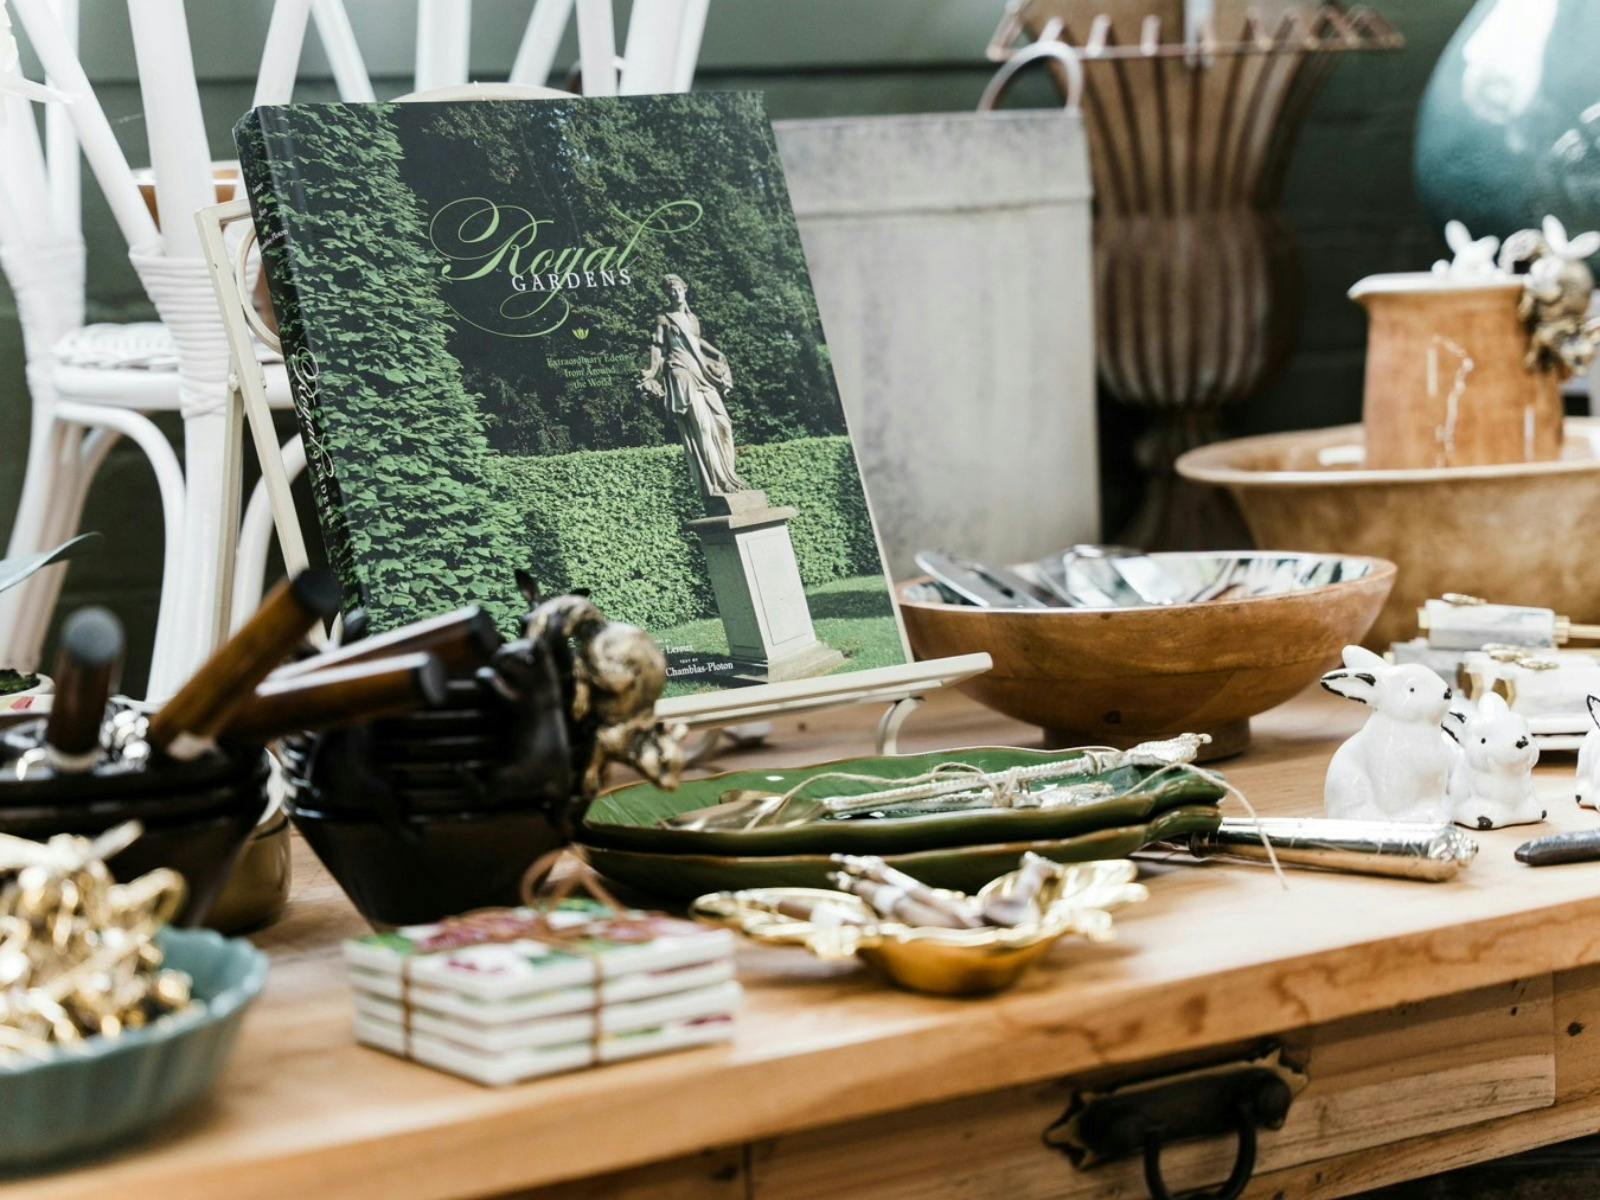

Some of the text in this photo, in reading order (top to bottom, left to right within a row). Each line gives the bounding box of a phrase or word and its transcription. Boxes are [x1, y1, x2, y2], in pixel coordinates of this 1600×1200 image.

[429, 196, 704, 338] Royal
[511, 268, 632, 292] GARDENS
[587, 365, 616, 376] Around
[587, 377, 613, 387] World
